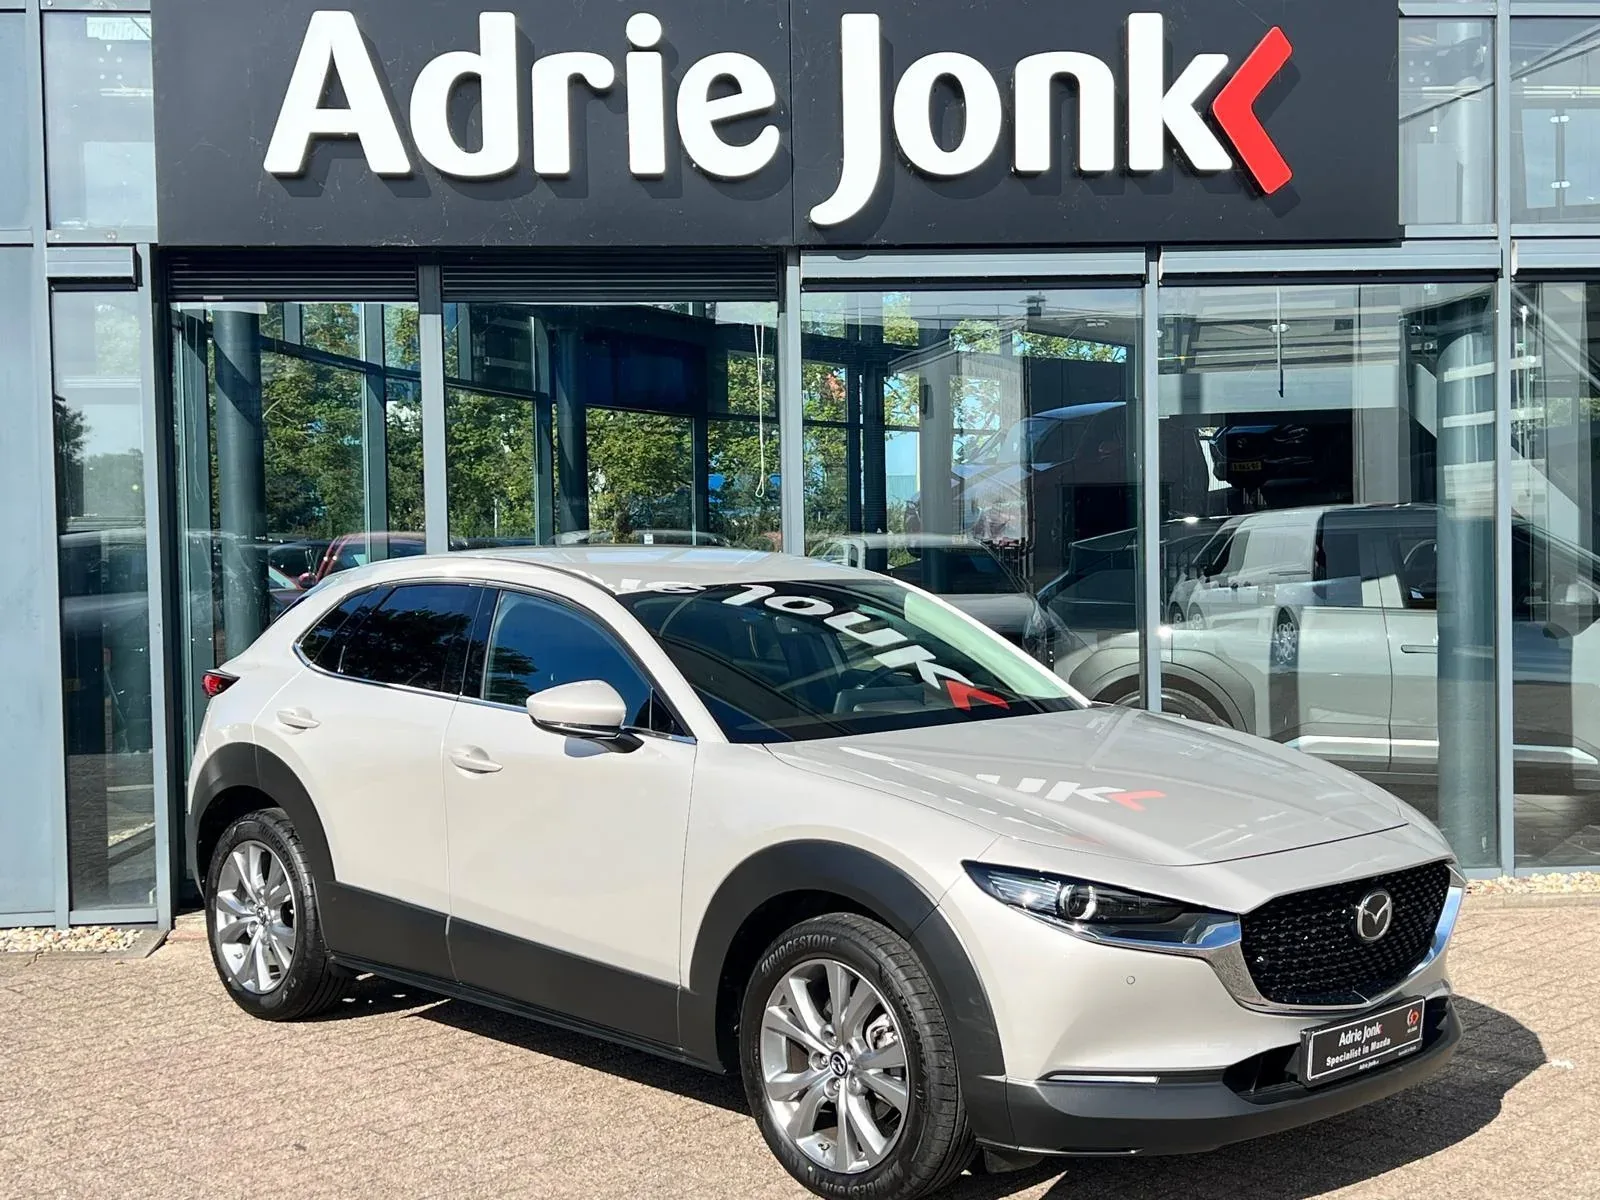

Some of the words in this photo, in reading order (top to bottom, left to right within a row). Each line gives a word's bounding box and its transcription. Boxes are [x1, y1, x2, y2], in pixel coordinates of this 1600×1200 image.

[263, 10, 781, 179] Adrie
[809, 13, 1232, 227] Jonk
[760, 933, 837, 975] BRIDGESTONE
[1338, 1028, 1363, 1047] Adrie
[1361, 1021, 1381, 1044] Jonk
[1326, 1046, 1362, 1067] Specialist
[1362, 1044, 1370, 1056] in
